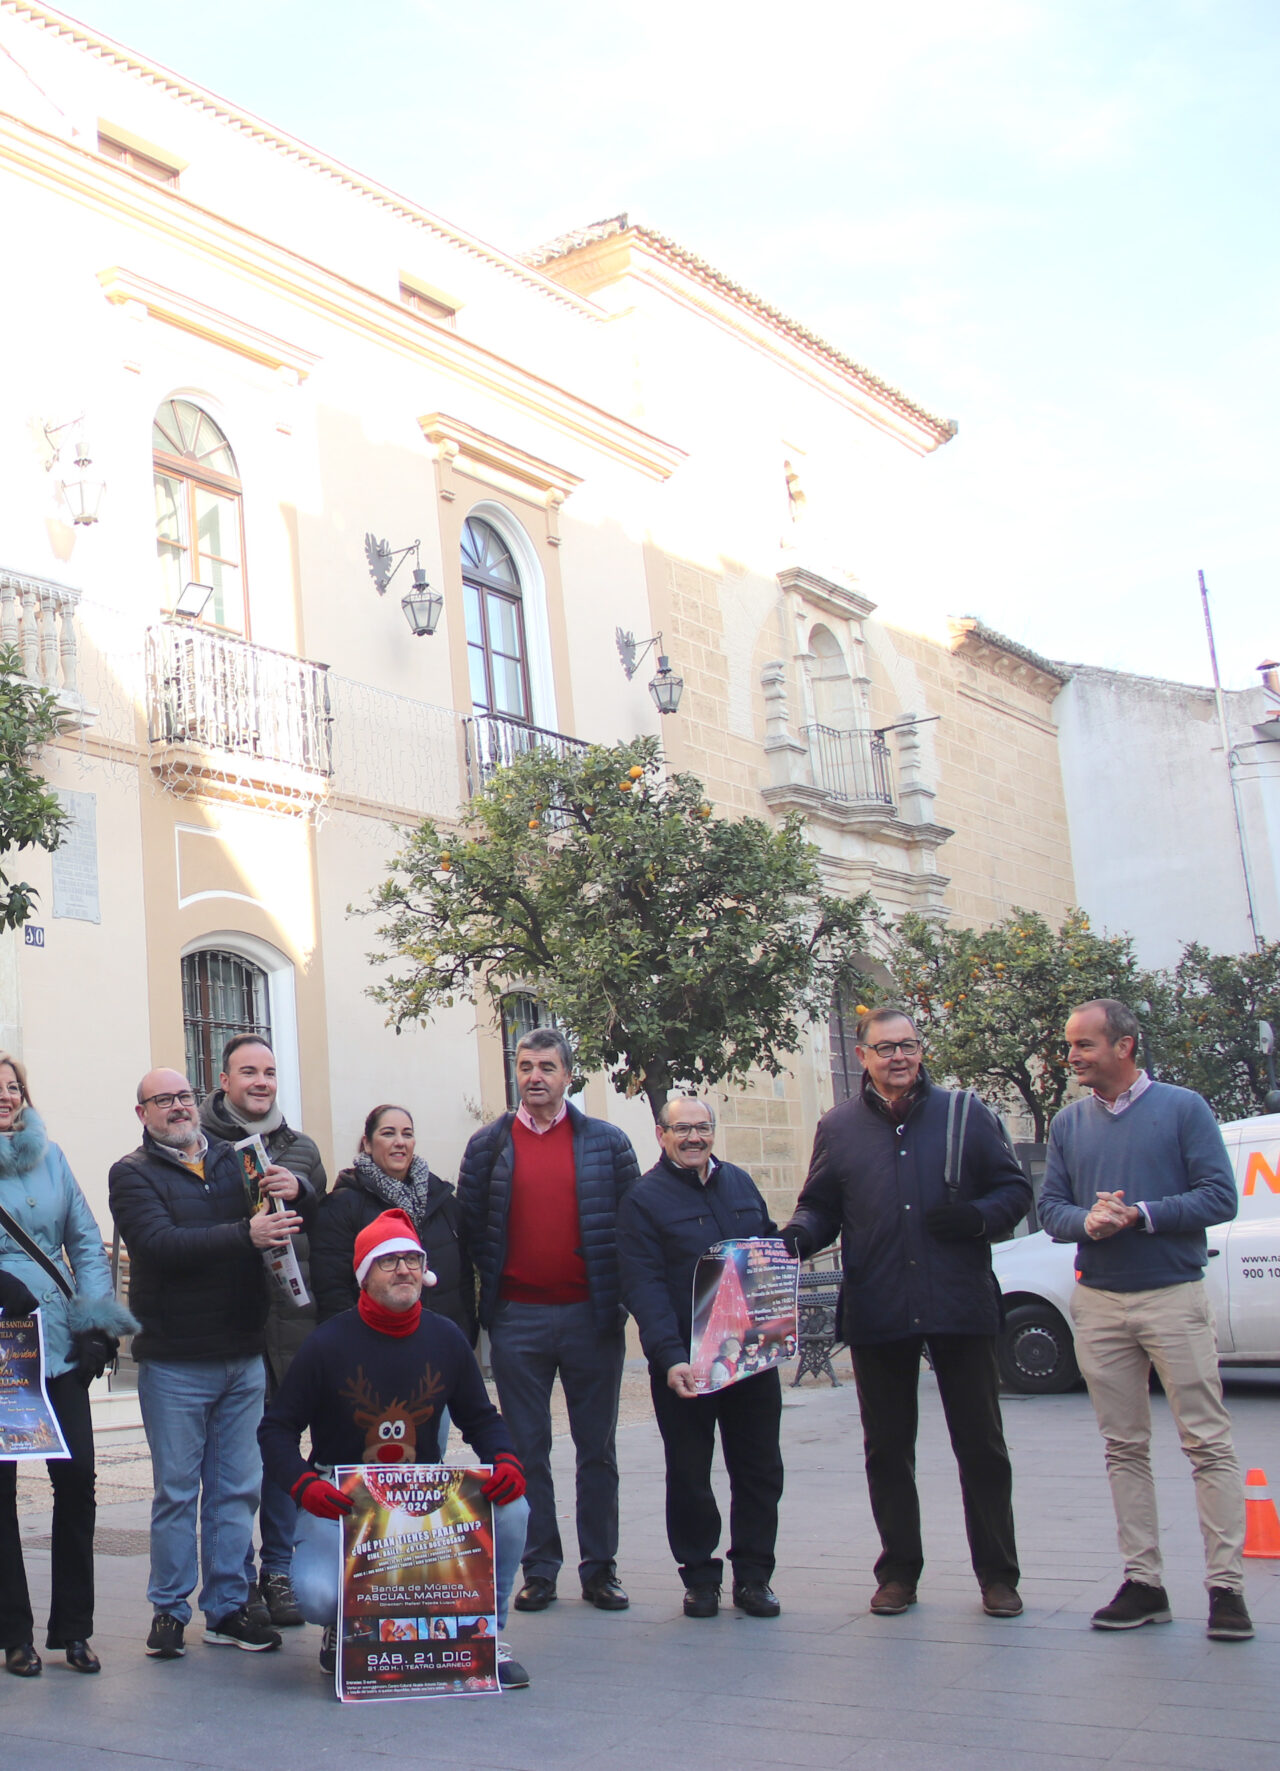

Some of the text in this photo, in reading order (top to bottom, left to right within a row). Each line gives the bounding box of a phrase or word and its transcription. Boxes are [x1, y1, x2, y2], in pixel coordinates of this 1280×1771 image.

[1243, 1269, 1263, 1279] 900
[6, 1320, 34, 1329] SANTIAGO
[377, 1471, 450, 1483] CONCIERTO
[386, 1490, 441, 1502] NAVIDAD
[400, 1502, 428, 1512] 2024
[351, 1520, 482, 1557] ¿QUÉ PLAN TIENES PARA HOY?
[442, 1535, 466, 1546] COSAS?
[371, 1582, 464, 1593] Banda de Música
[357, 1590, 480, 1602] PASCUAL MARQUINA
[367, 1651, 472, 1665] SÁB. 21 DIC
[436, 1661, 472, 1669] GARNELO
